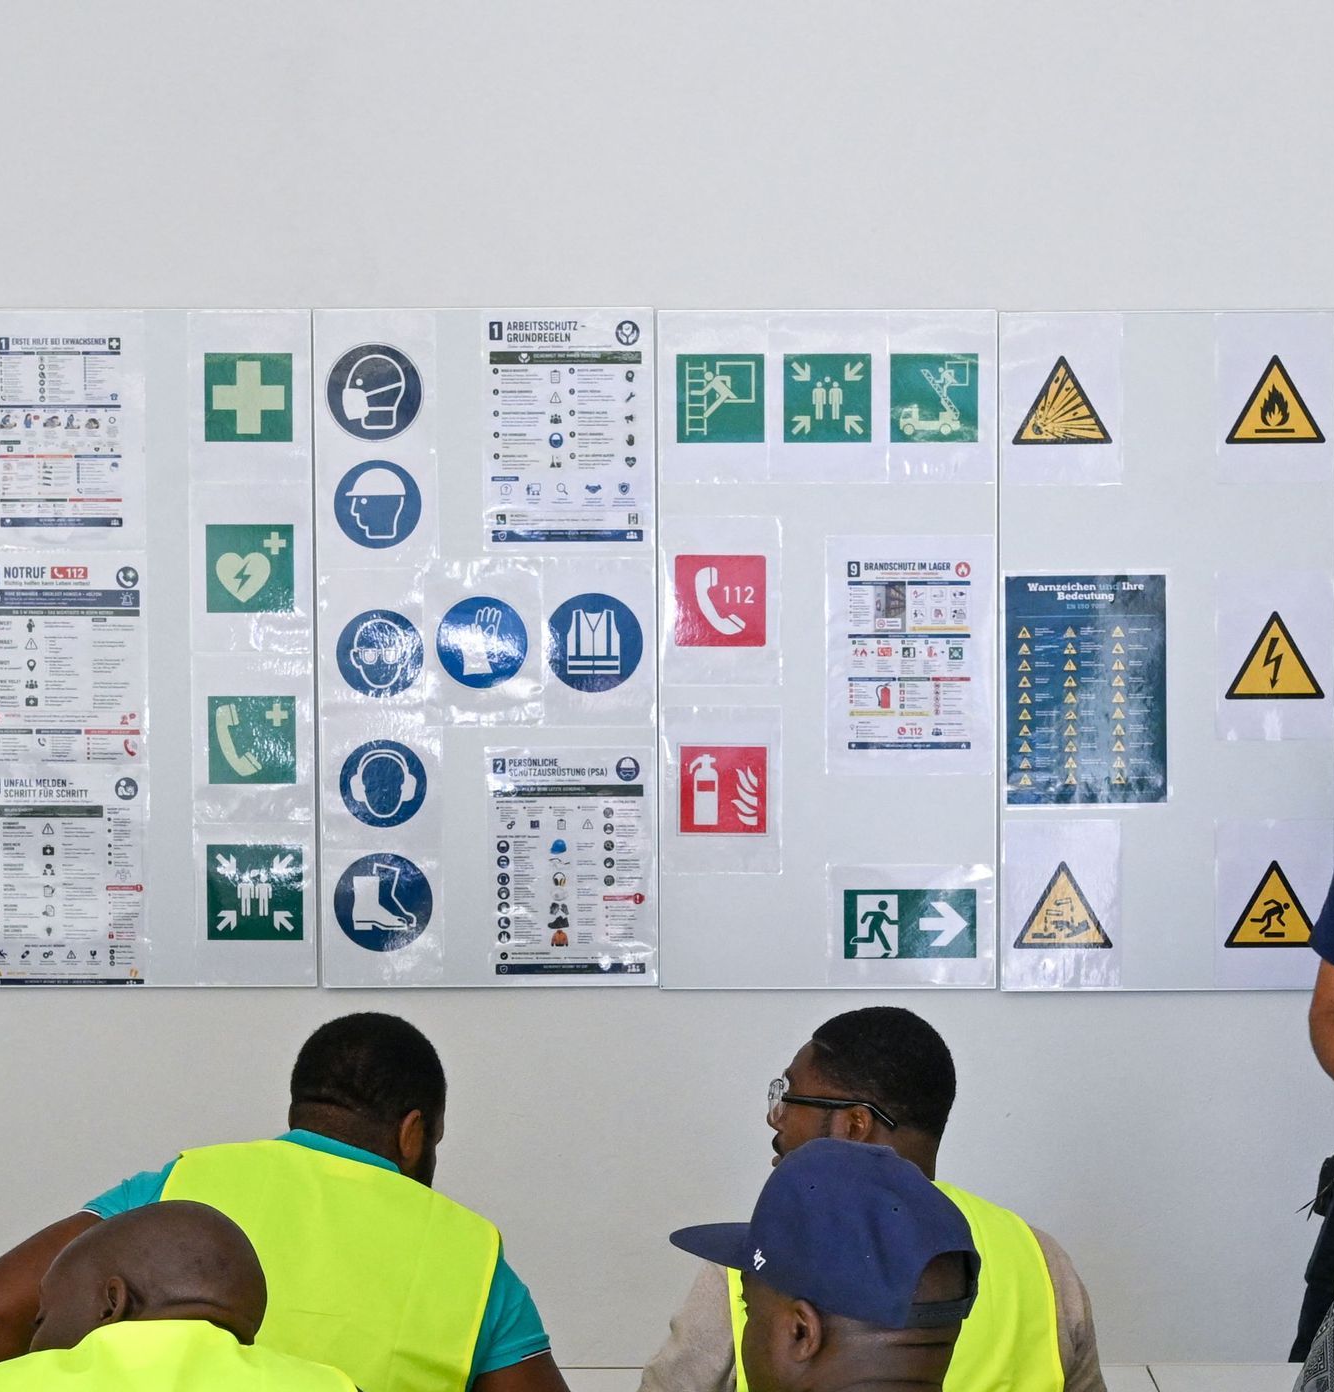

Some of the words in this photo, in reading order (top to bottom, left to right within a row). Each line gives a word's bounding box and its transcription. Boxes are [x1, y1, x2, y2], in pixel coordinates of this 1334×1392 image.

[492, 323, 500, 339] 1
[506, 321, 578, 331] ARBEITSSCHUTZ
[12, 338, 31, 346] ERSTE
[32, 338, 49, 346] HILFE
[50, 338, 61, 346] BEI
[62, 338, 107, 346] ERWACHSENEN
[506, 333, 571, 343] GRUNDREGELN
[4, 566, 47, 579] NOTRUF
[65, 567, 85, 578] 112
[850, 563, 858, 576] 9
[864, 562, 916, 571] BRANDSCHUTZ
[917, 562, 927, 571] IM
[928, 562, 951, 571] LAGER
[1027, 582, 1097, 592] Warnzeichen
[1121, 581, 1145, 592] Ihre
[723, 586, 755, 604] 112
[1056, 592, 1115, 602] Bedeutung
[909, 727, 923, 736] 112
[495, 760, 504, 773] 2
[508, 756, 558, 767] PERSÖNLICHE
[508, 766, 586, 777] SCHUTZAUSRÜSTUNG
[587, 766, 608, 777] (PSA)
[3, 778, 32, 788] UNFALL
[35, 778, 67, 788] MELDEN
[3, 789, 36, 798] SCHRITT
[38, 788, 54, 798] FÜR
[55, 789, 89, 798] SCHRITT
